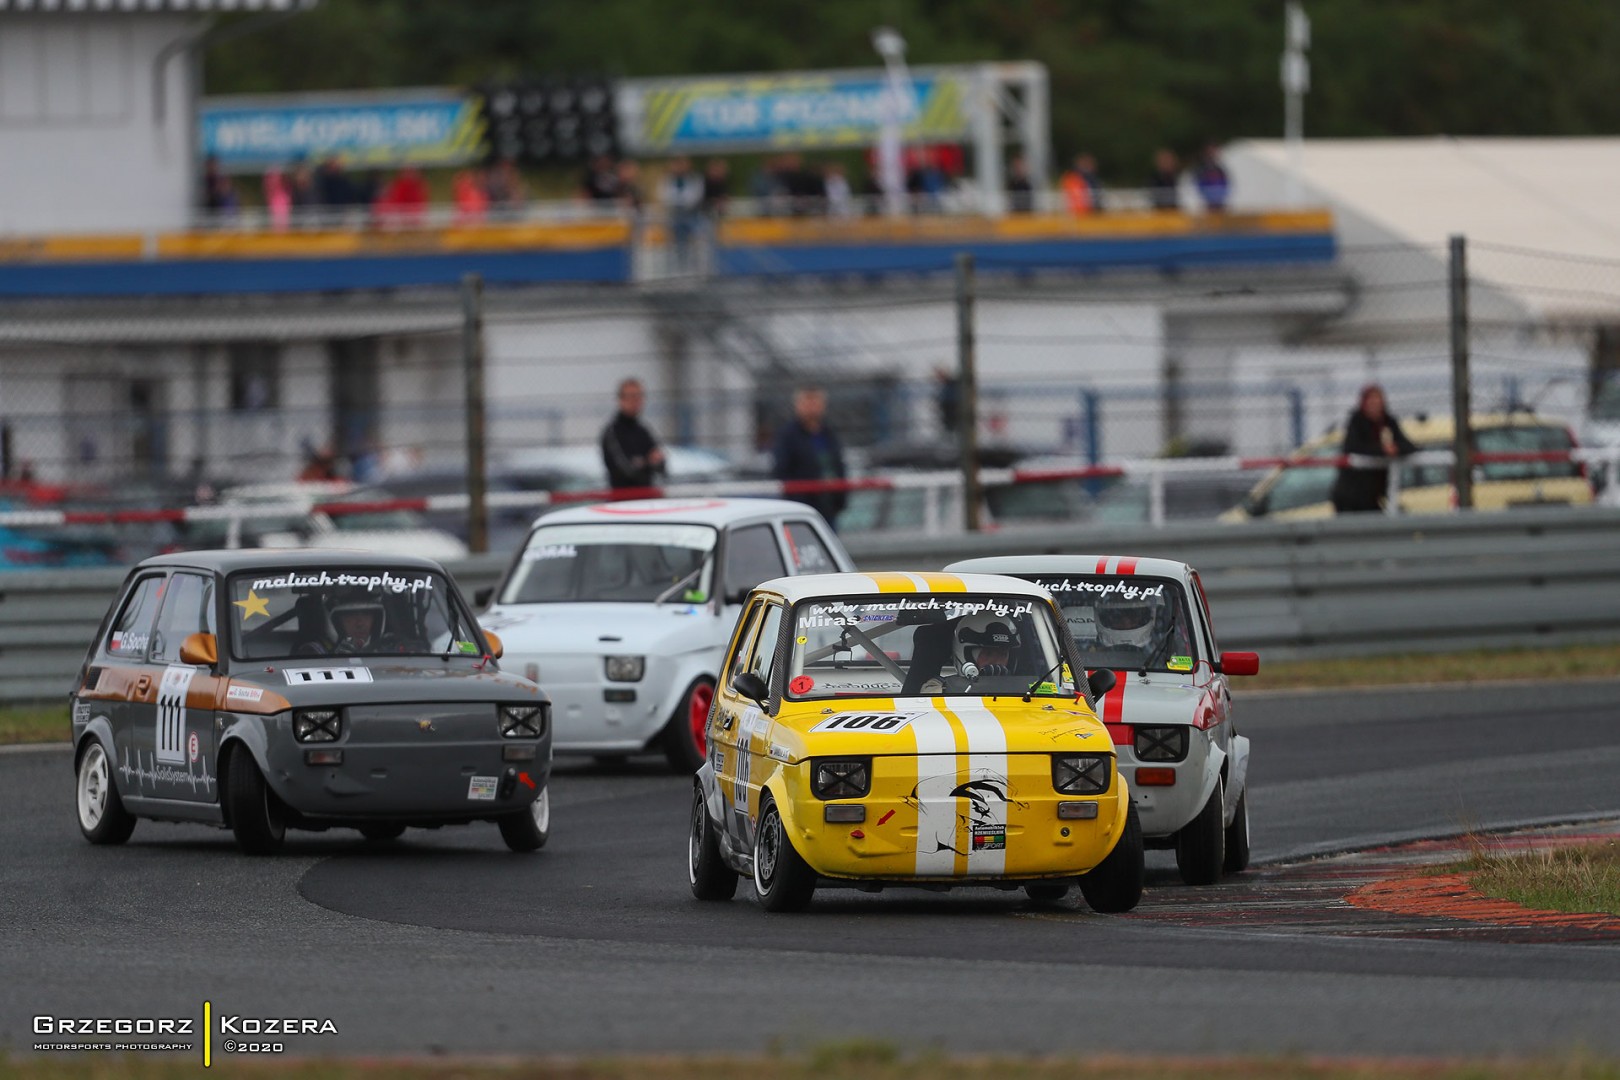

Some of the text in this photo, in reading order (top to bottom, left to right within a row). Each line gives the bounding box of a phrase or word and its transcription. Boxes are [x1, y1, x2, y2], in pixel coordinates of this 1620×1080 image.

[252, 571, 433, 593] maluch-trophy.pl
[1035, 578, 1164, 600] luch-trophy.pl
[812, 598, 1033, 617] www.maluch-trophy.pl
[799, 615, 859, 629] Miras
[296, 670, 355, 682] 111
[160, 694, 181, 752] 111
[825, 715, 907, 730] 106
